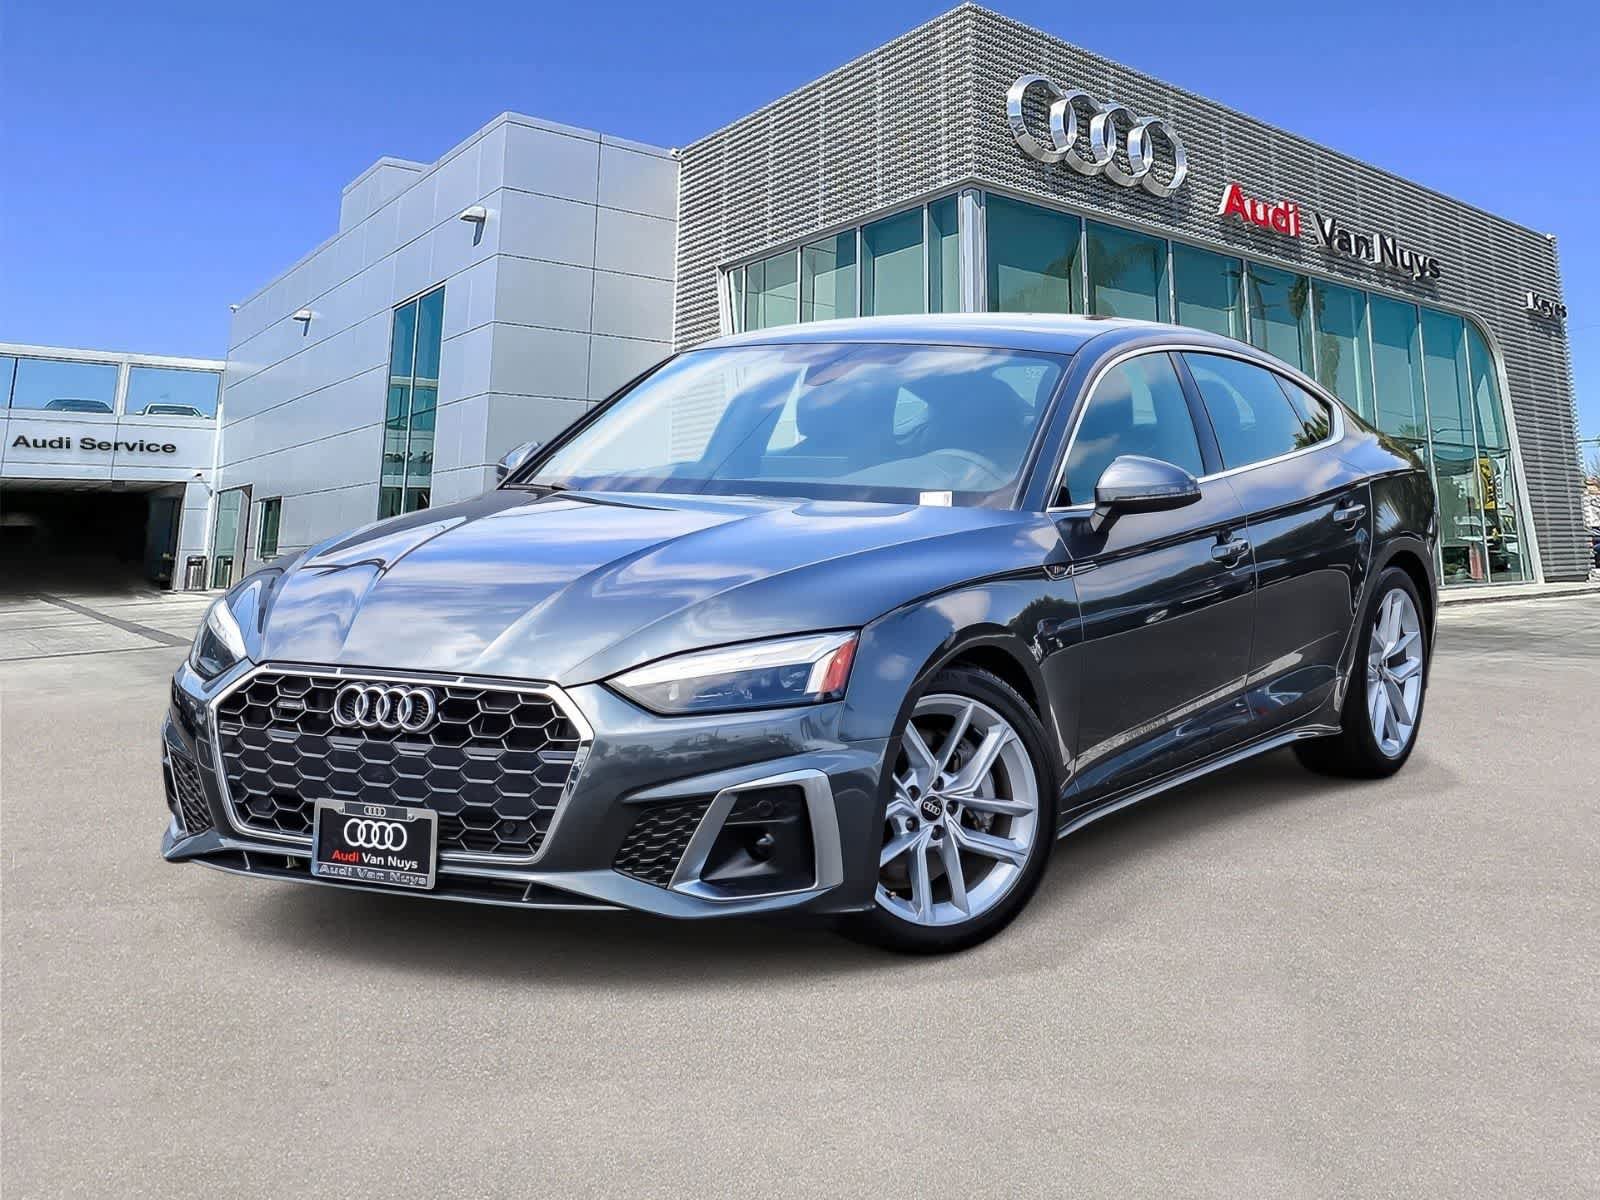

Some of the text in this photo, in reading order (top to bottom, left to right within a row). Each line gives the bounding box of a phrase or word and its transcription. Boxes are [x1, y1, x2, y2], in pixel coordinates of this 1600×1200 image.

[1219, 183, 1442, 280] Audi Van Nuys
[12, 435, 177, 454] Audi Service
[332, 849, 418, 871] Audi Van Nuys
[319, 864, 427, 886] Audi Van Nuys
